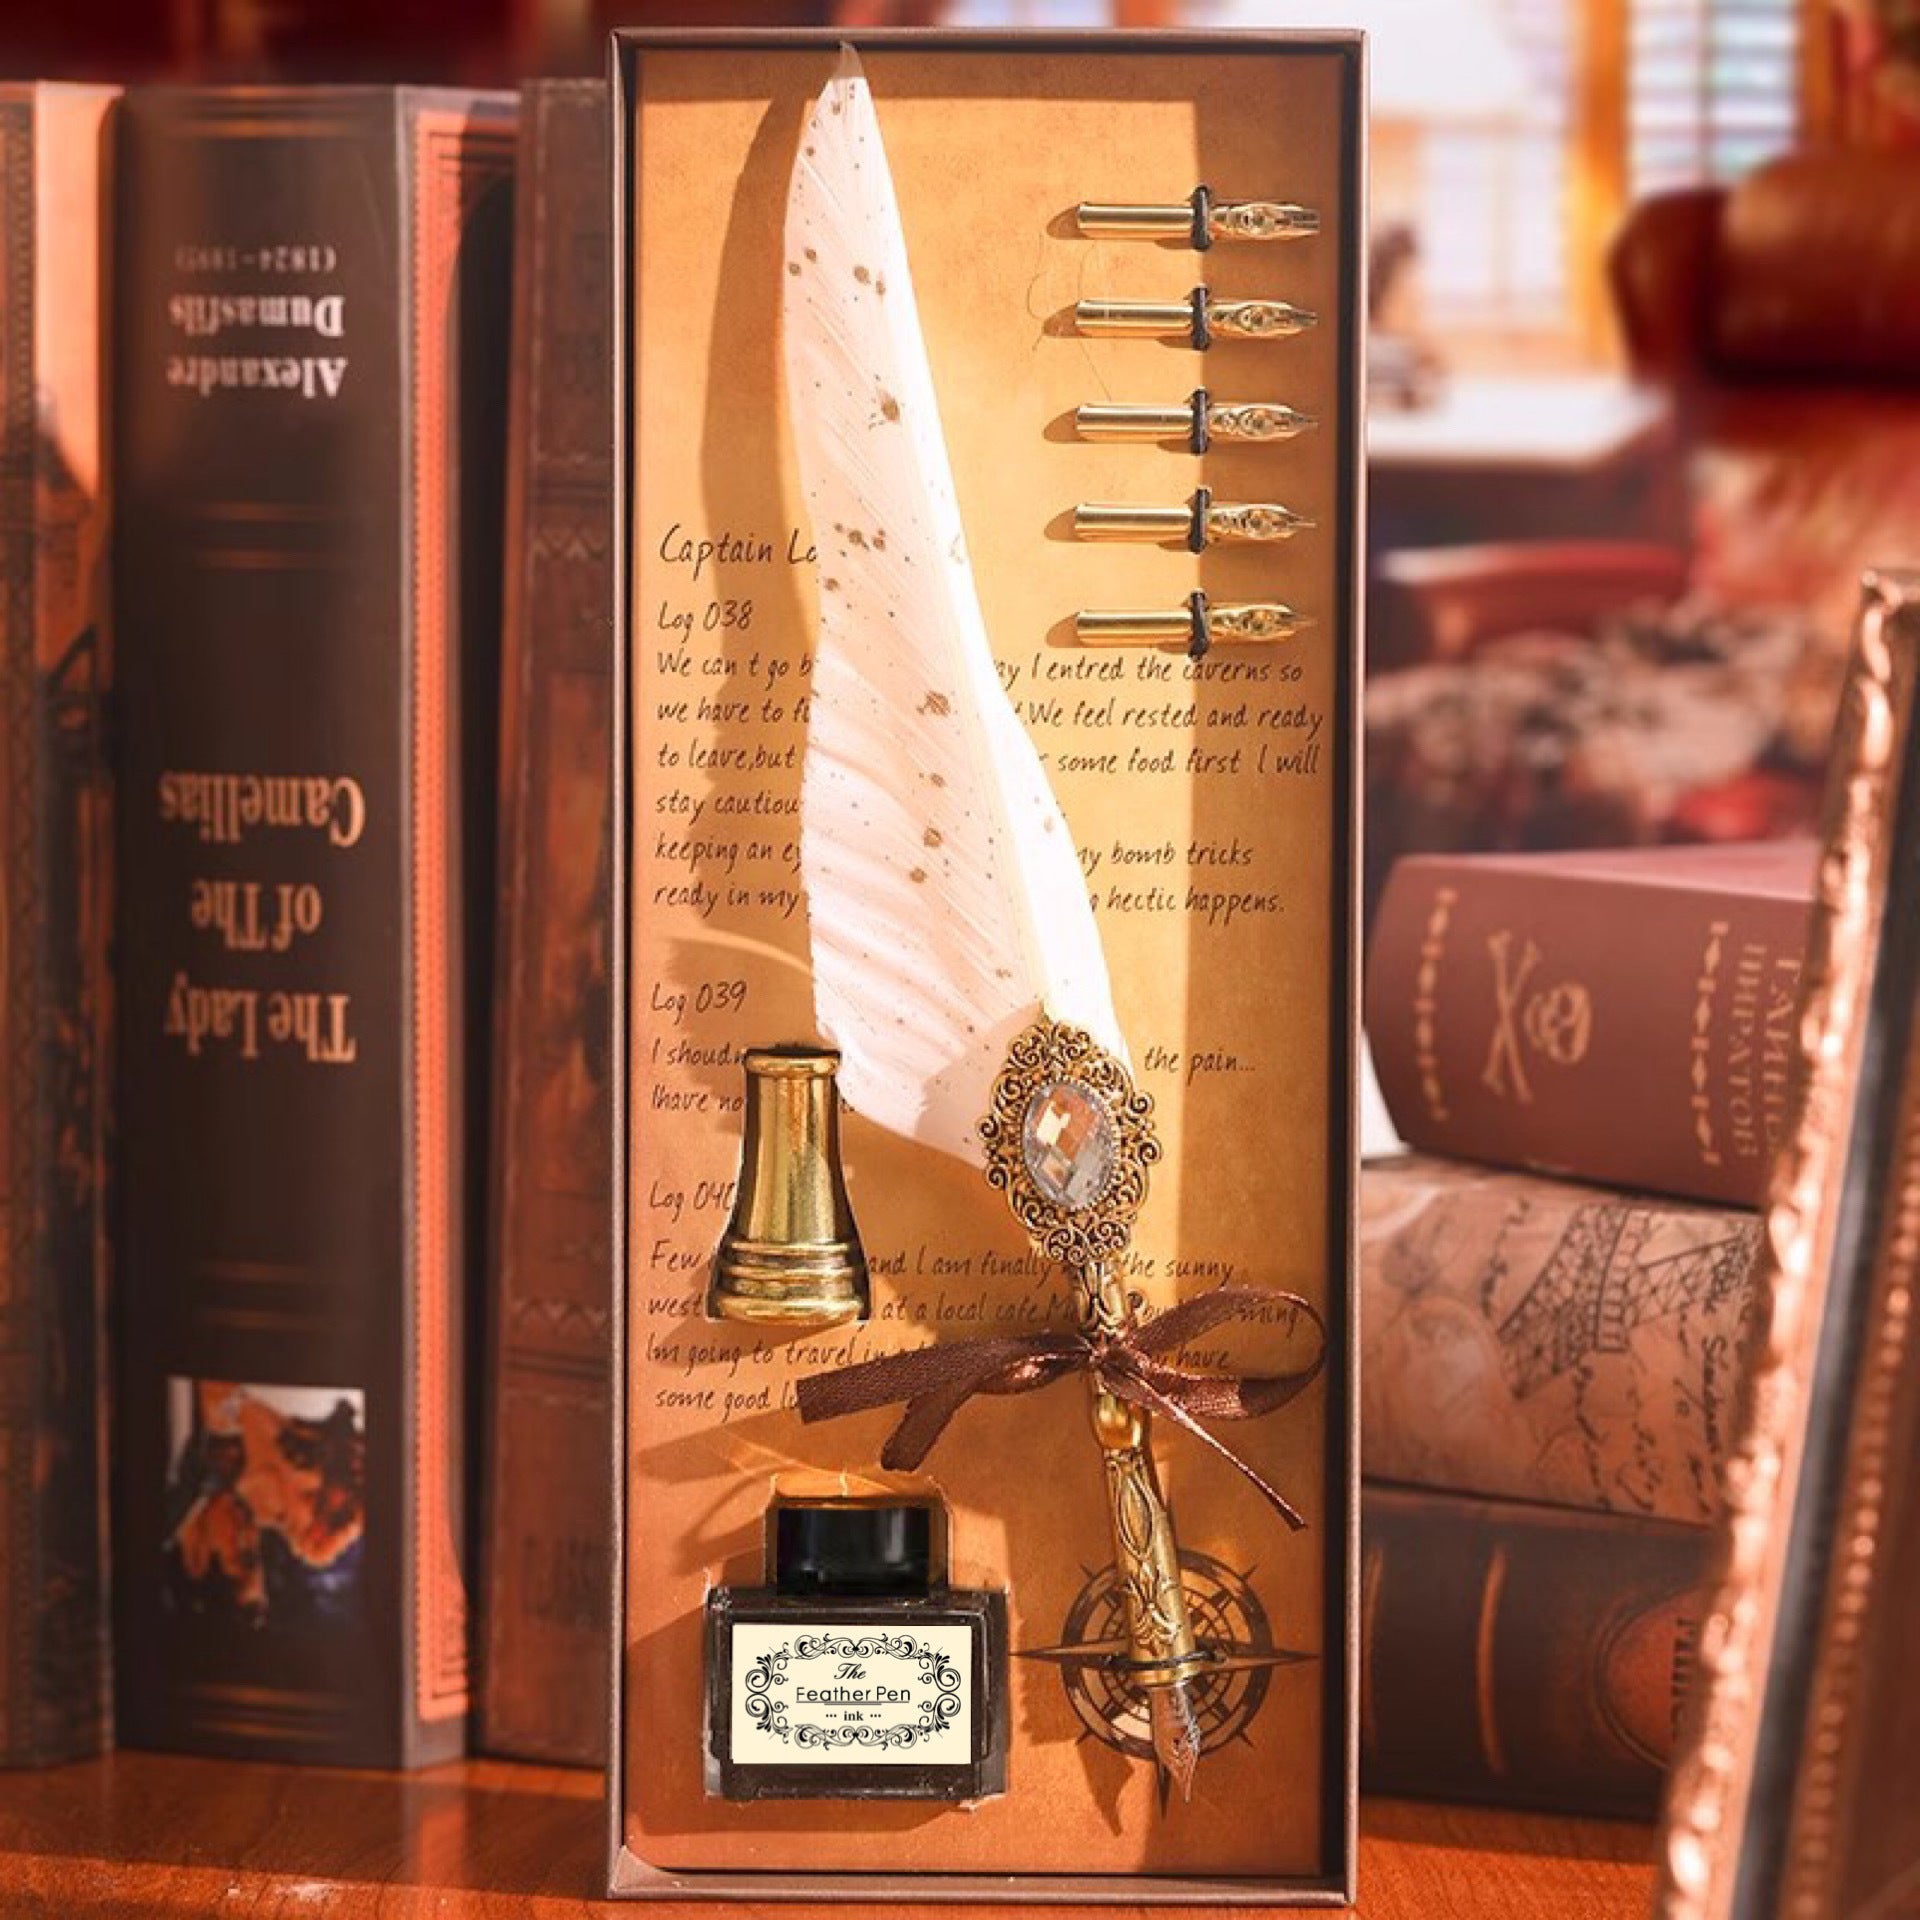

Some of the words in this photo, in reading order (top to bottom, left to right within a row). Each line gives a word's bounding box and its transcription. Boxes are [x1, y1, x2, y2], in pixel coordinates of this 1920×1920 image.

[168, 295, 345, 338] Dumasfils
[166, 356, 348, 398] Alexandre
[660, 522, 773, 581] Captain
[657, 600, 694, 643] Log
[702, 599, 753, 631] 038
[657, 648, 691, 677] We
[702, 659, 737, 675] can
[766, 661, 790, 691] go
[1047, 655, 1124, 682] entred
[1137, 655, 1172, 681] the
[1182, 662, 1270, 682] caverns
[1279, 667, 1303, 682] so
[657, 702, 688, 723] we
[696, 697, 750, 723] have
[761, 698, 784, 723] to
[1073, 697, 1116, 728] feel
[1122, 703, 1197, 728] rested
[1207, 703, 1248, 728] and
[1257, 703, 1324, 742] ready
[658, 742, 680, 769] to
[1057, 753, 1118, 773] some
[1127, 747, 1176, 773] food
[1185, 748, 1243, 774] first
[1276, 743, 1322, 774] will
[160, 770, 366, 848] Camellias
[655, 790, 704, 827] stay
[654, 831, 738, 876] keeping
[746, 841, 772, 860] an
[1111, 840, 1176, 865] bomb
[1187, 838, 1254, 866] tricks
[191, 880, 268, 949] The
[273, 883, 323, 951] of
[654, 882, 719, 919] ready
[728, 884, 751, 906] in
[759, 891, 800, 919] my
[1106, 885, 1177, 913] hectic
[1184, 885, 1286, 927] happens.
[165, 972, 260, 1060] Lady
[651, 982, 688, 1025] Log
[695, 980, 748, 1013] 039
[268, 992, 358, 1062] The
[1144, 1046, 1180, 1073] the
[650, 1180, 682, 1224] Log
[651, 1238, 703, 1273] Few
[868, 1252, 906, 1275] and
[932, 1257, 970, 1276] am
[980, 1249, 1051, 1290] finally
[1165, 1259, 1235, 1288] sunny
[648, 1291, 703, 1318] west
[882, 1296, 906, 1321] at
[914, 1302, 927, 1318] a
[935, 1293, 986, 1321] local
[686, 1341, 742, 1378] going
[752, 1339, 774, 1364] to
[785, 1336, 856, 1366] travel
[1175, 1343, 1230, 1368] have
[655, 1387, 715, 1410] some
[722, 1385, 772, 1424] good
[833, 1663, 867, 1680] The
[796, 1686, 871, 1702] Feather
[876, 1686, 911, 1702] Pen
[843, 1710, 864, 1722] ink
